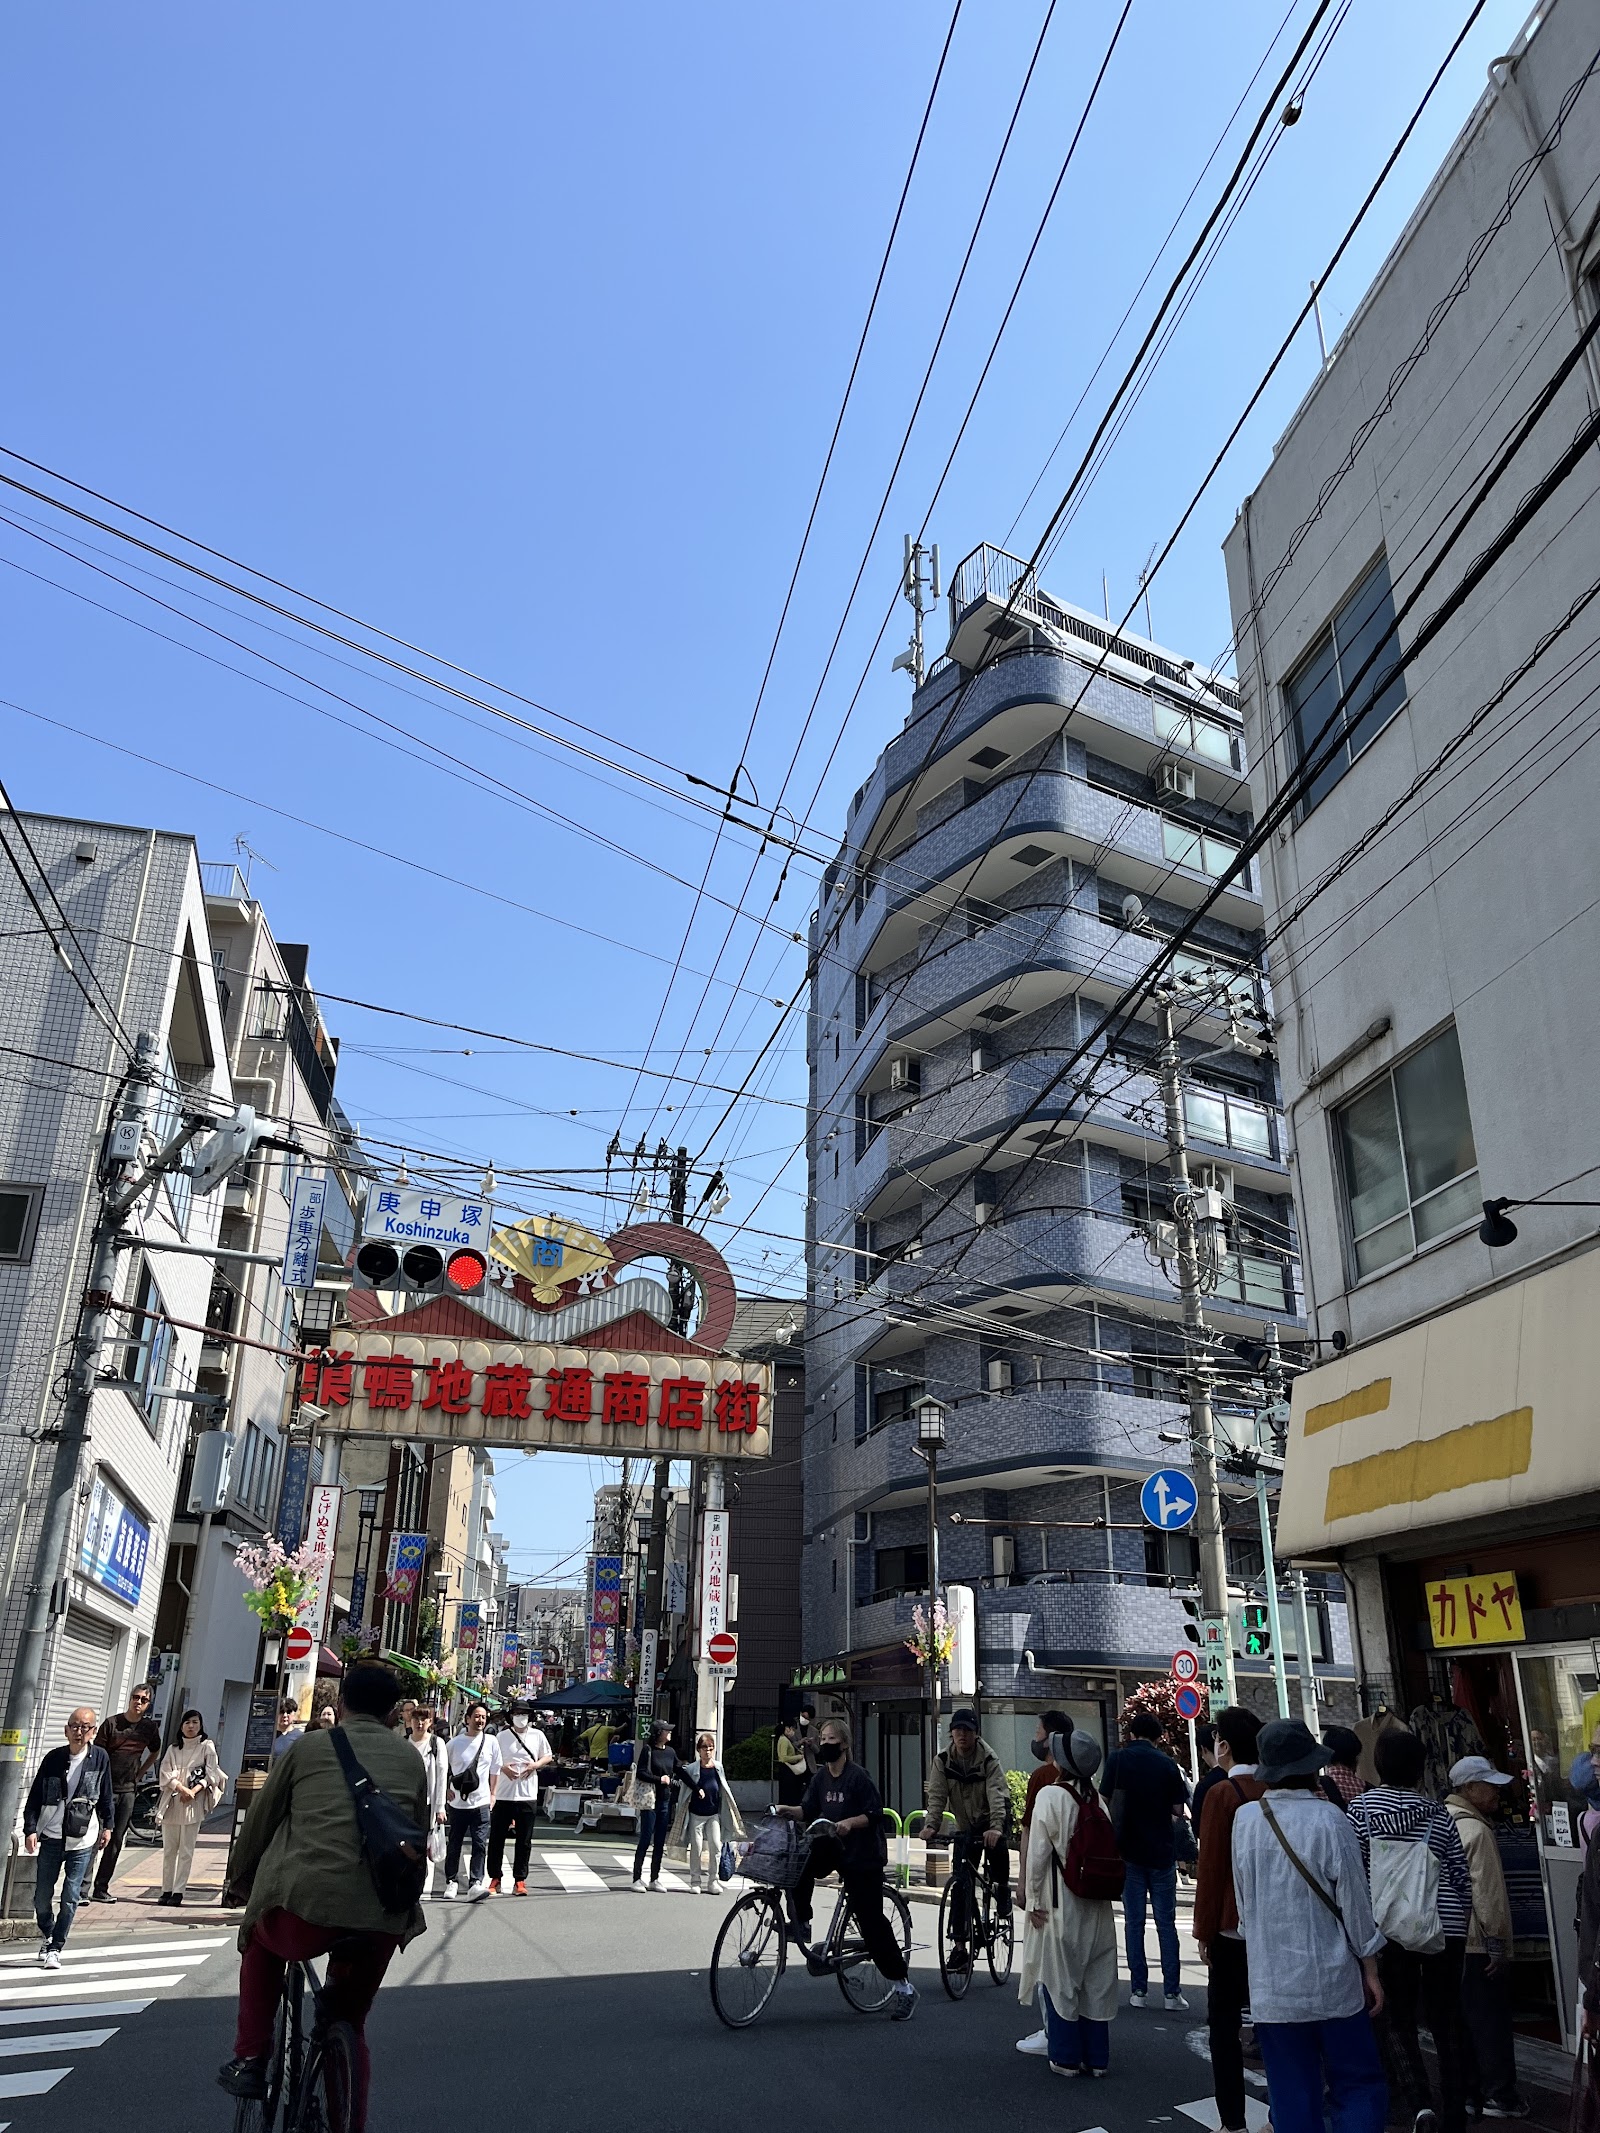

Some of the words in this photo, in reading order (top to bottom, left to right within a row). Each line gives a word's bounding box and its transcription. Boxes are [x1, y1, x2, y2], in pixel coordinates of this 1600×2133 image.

[309, 1185, 323, 1204] 一部
[376, 1191, 483, 1227] 庚申塚
[290, 1205, 316, 1284] 歩車分離式
[384, 1216, 470, 1245] Koshinzuka
[532, 1235, 565, 1268] 商
[299, 1348, 760, 1435] 巣鴨地蔵通商店街
[712, 1514, 720, 1532] 史跡
[709, 1534, 722, 1603] 江戸六地蔵
[1432, 1581, 1515, 1640] カドヤ
[285, 1662, 309, 1671] 転車を除く
[1178, 1659, 1192, 1674] 30
[1208, 1654, 1224, 1693] 小林
